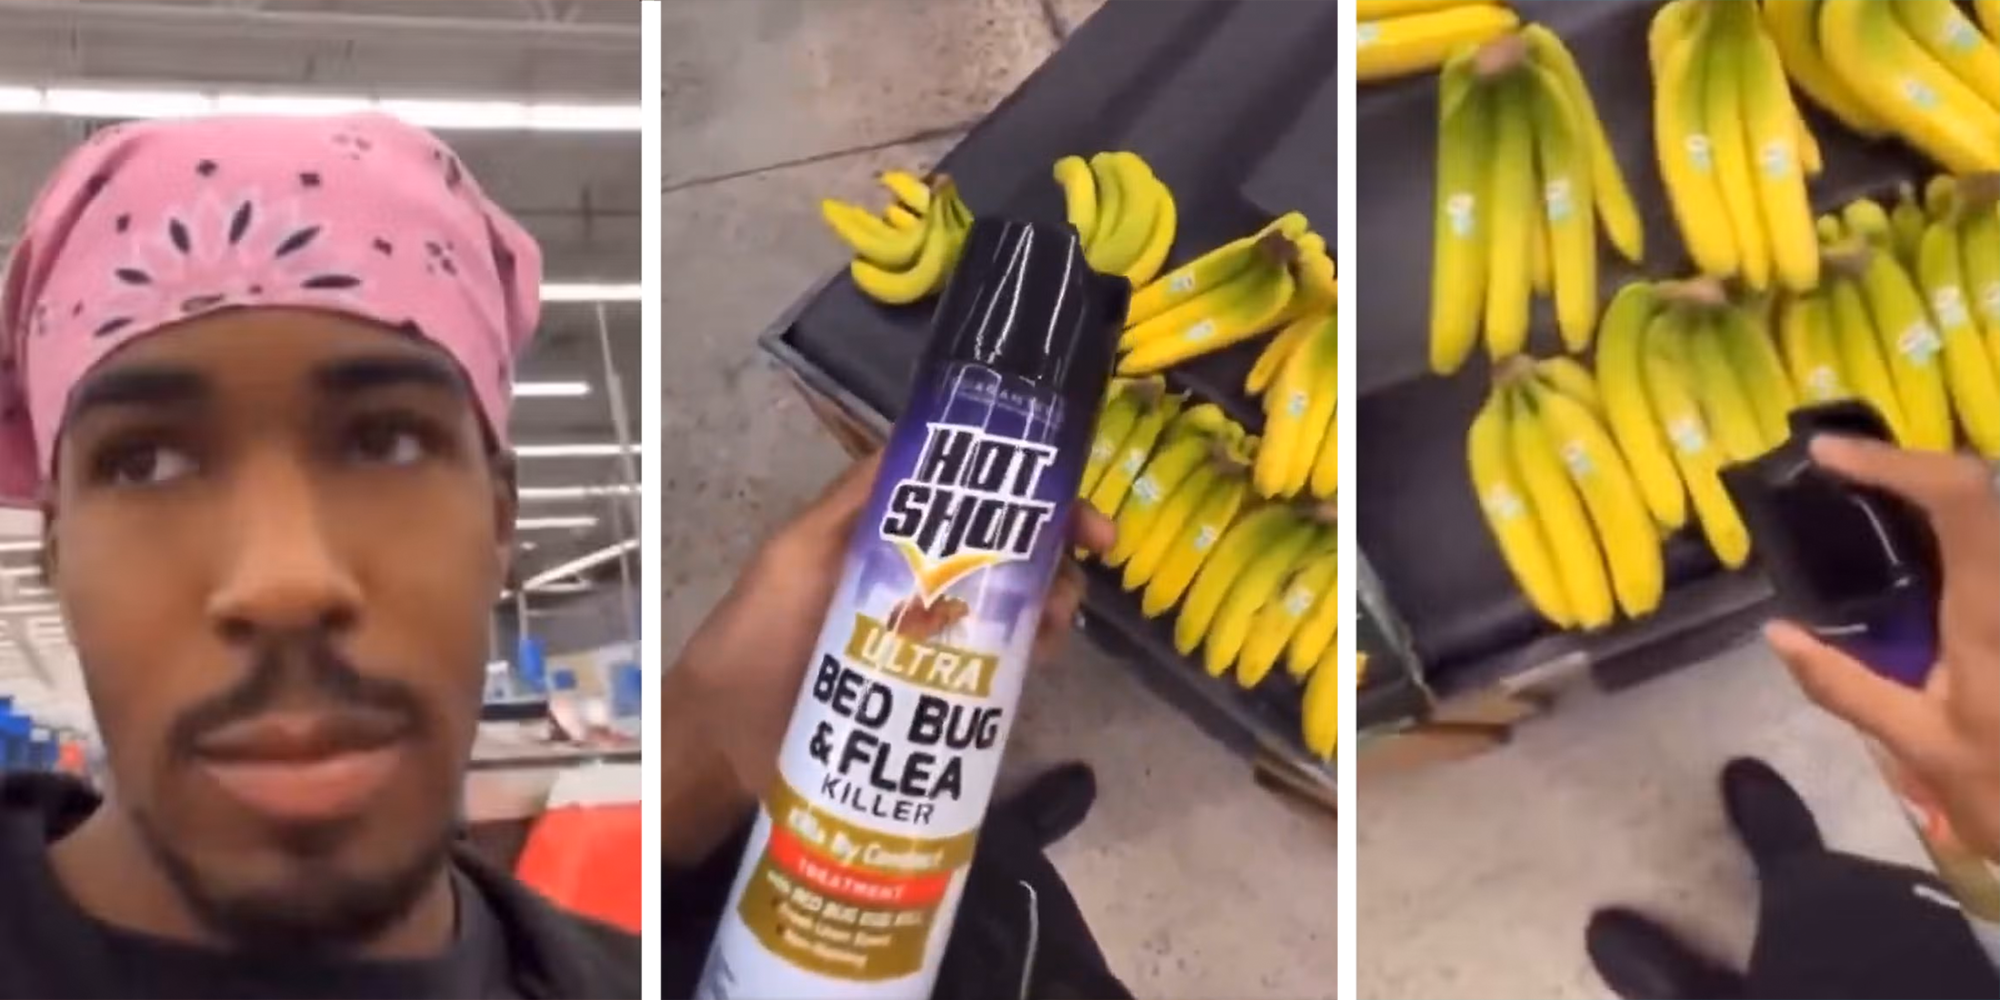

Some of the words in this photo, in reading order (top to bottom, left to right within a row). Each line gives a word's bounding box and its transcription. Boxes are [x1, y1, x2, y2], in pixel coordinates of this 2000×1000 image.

[914, 423, 1056, 500] HOT
[881, 480, 1054, 559] SHOT
[860, 627, 983, 693] ULTRA
[812, 653, 893, 730] BED
[907, 694, 1003, 750] BUG
[809, 720, 834, 767] &
[838, 729, 962, 801] FLEA
[821, 773, 935, 825] KILLER
[799, 856, 907, 899] TREATMENT
